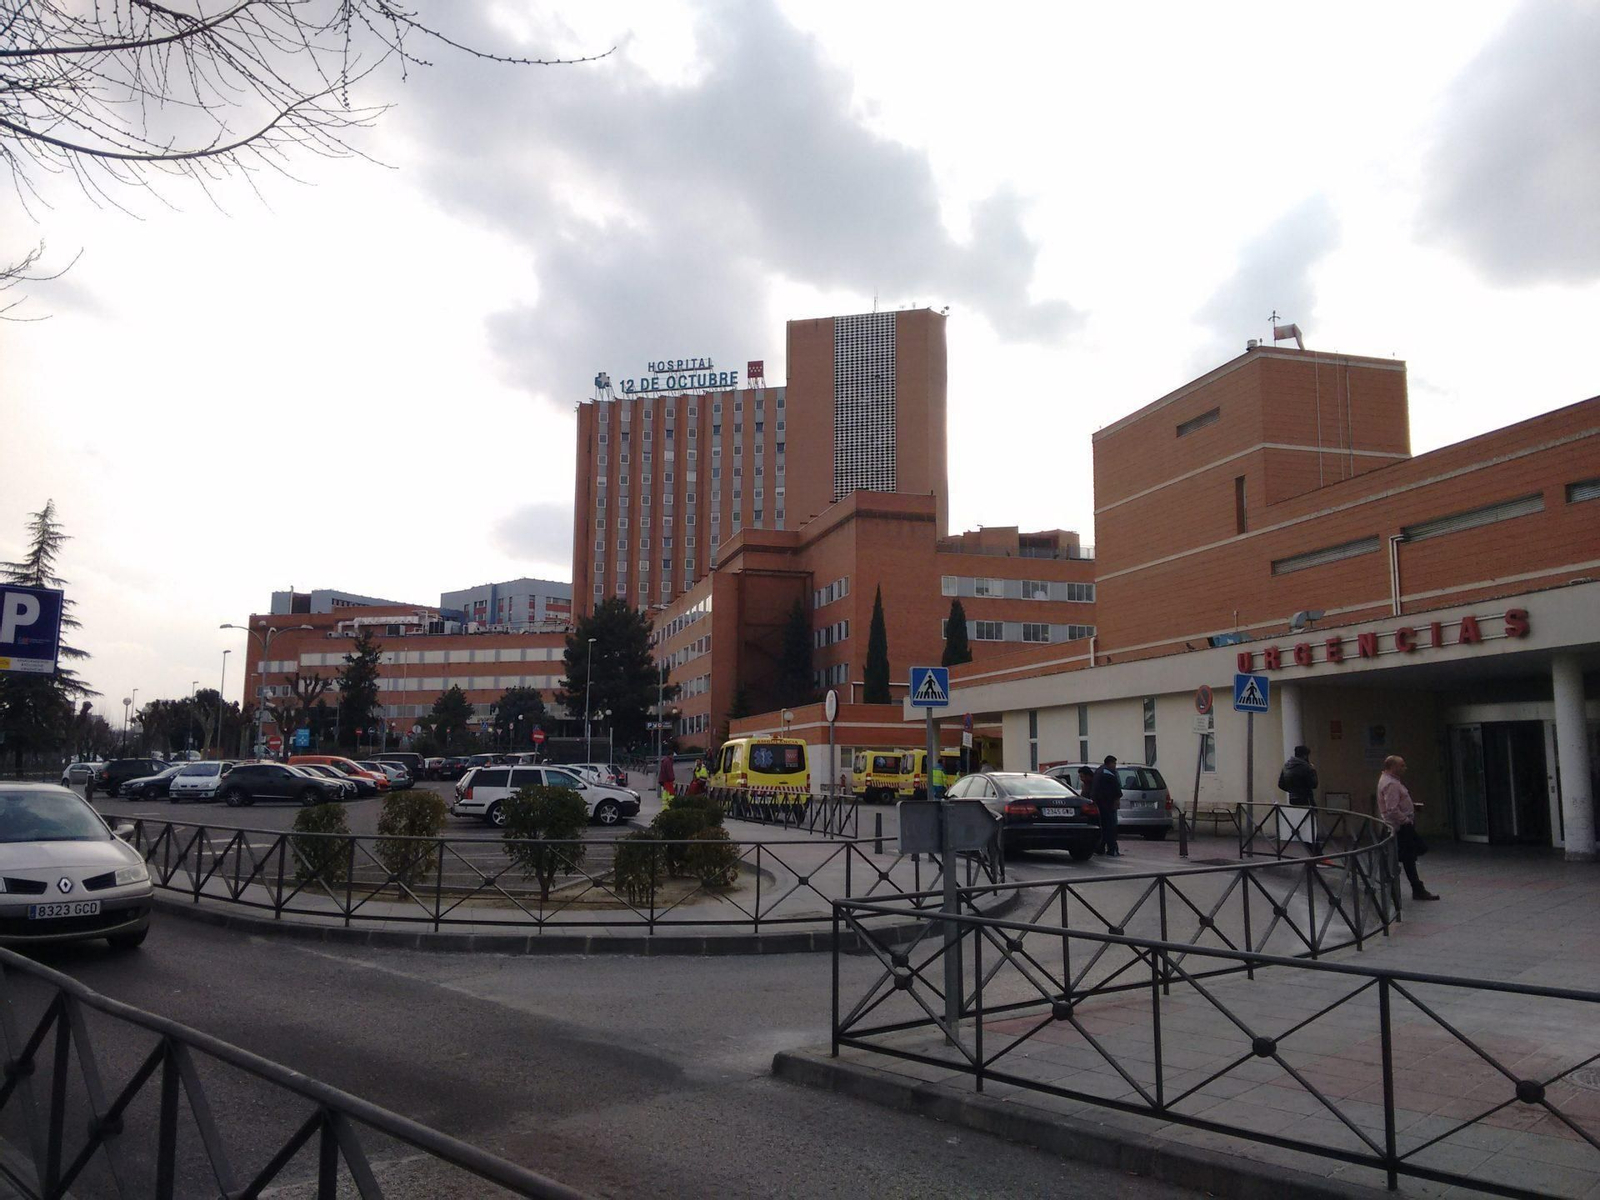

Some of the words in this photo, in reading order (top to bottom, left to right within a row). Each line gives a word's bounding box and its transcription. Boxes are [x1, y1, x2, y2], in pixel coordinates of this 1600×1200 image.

[648, 358, 714, 372] HOSPITAL
[620, 379, 634, 393] 12
[640, 377, 659, 391] DE
[666, 371, 738, 389] OCTUBRE
[0, 591, 40, 643] P
[1237, 608, 1531, 674] URGENCIAS
[38, 904, 70, 917] 8323
[74, 902, 97, 914] GCD
